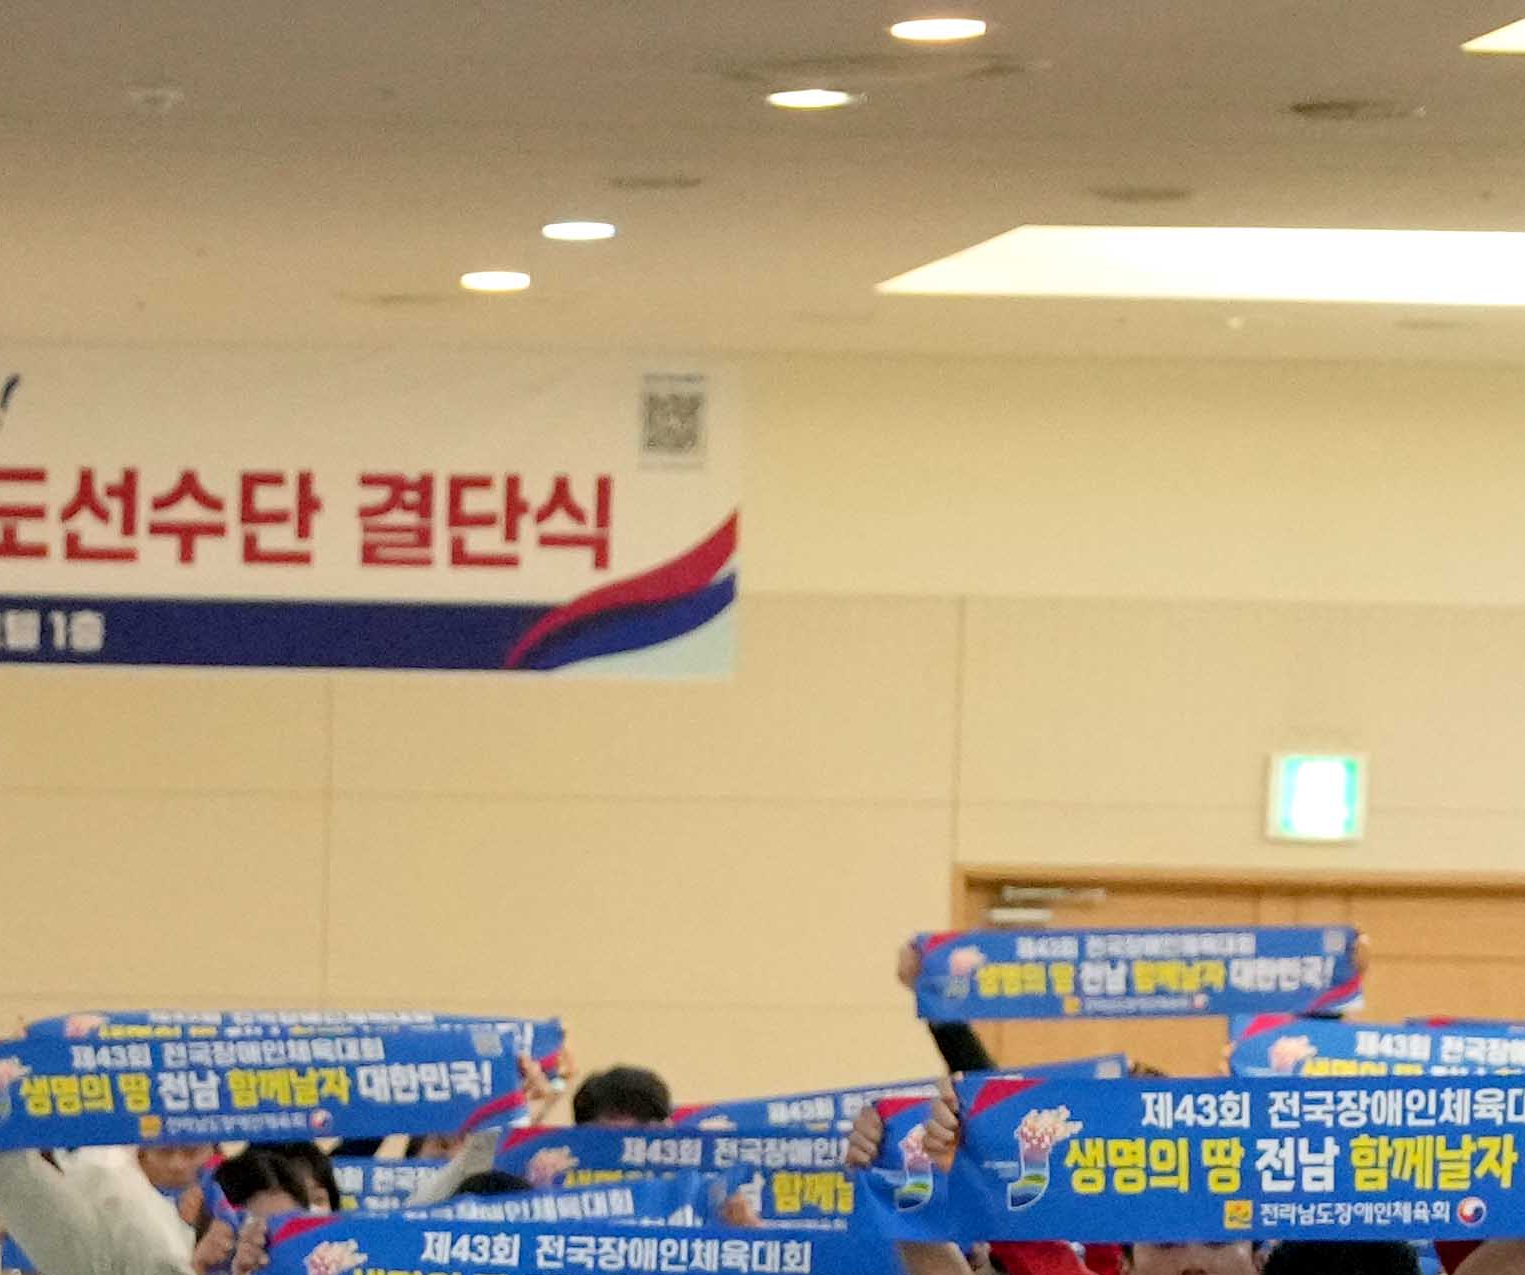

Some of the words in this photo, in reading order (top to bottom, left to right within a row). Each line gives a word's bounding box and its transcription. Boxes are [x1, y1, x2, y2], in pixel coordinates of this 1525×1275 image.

[354, 470, 615, 571] 결단식
[1142, 1091, 1250, 1129] 제43회
[1065, 1138, 1189, 1194] 생명의
[1201, 1137, 1245, 1193] 땅
[1256, 1136, 1340, 1192] 전남
[1350, 1134, 1518, 1191] 함께날자
[1261, 1201, 1450, 1226] 전라남도장애인체육회
